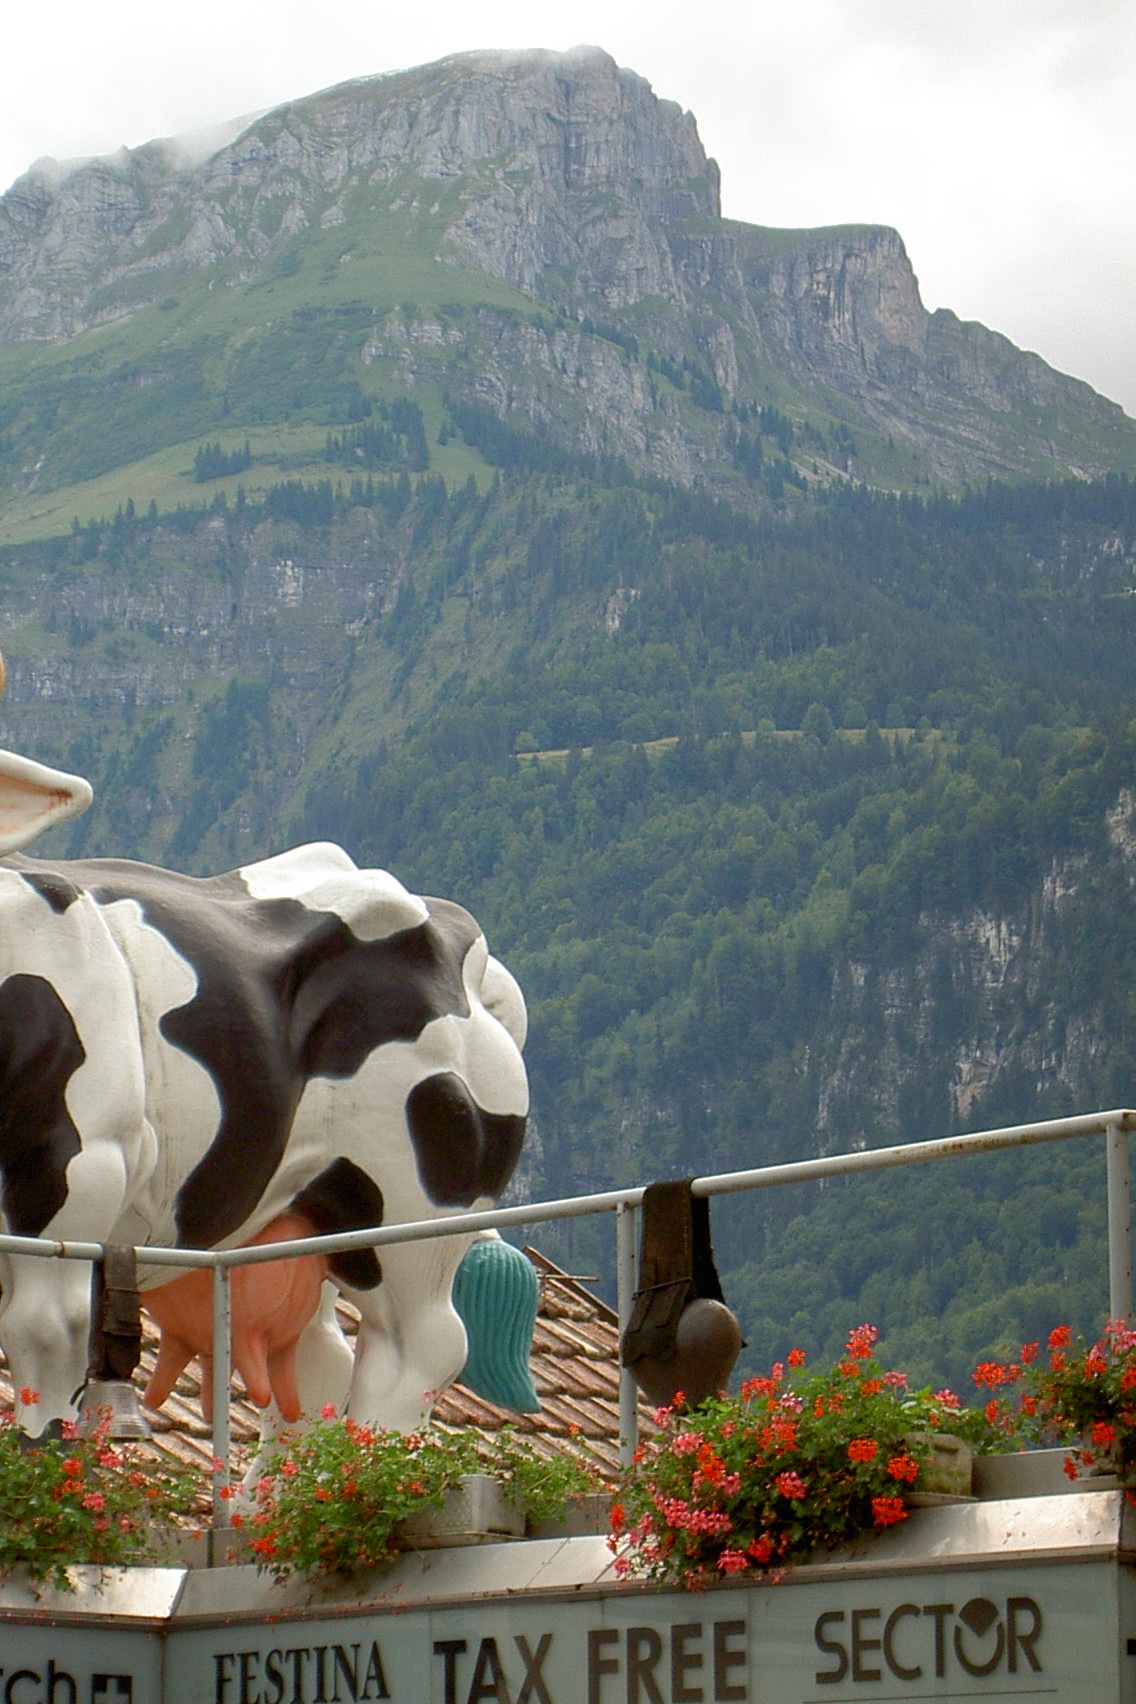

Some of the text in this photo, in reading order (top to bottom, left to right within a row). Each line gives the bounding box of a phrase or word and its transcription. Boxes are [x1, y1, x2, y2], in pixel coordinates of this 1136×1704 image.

[213, 1640, 391, 1704] FESTINA
[433, 1620, 746, 1704] TAX FREE
[815, 1597, 1043, 1684] SECTOR
